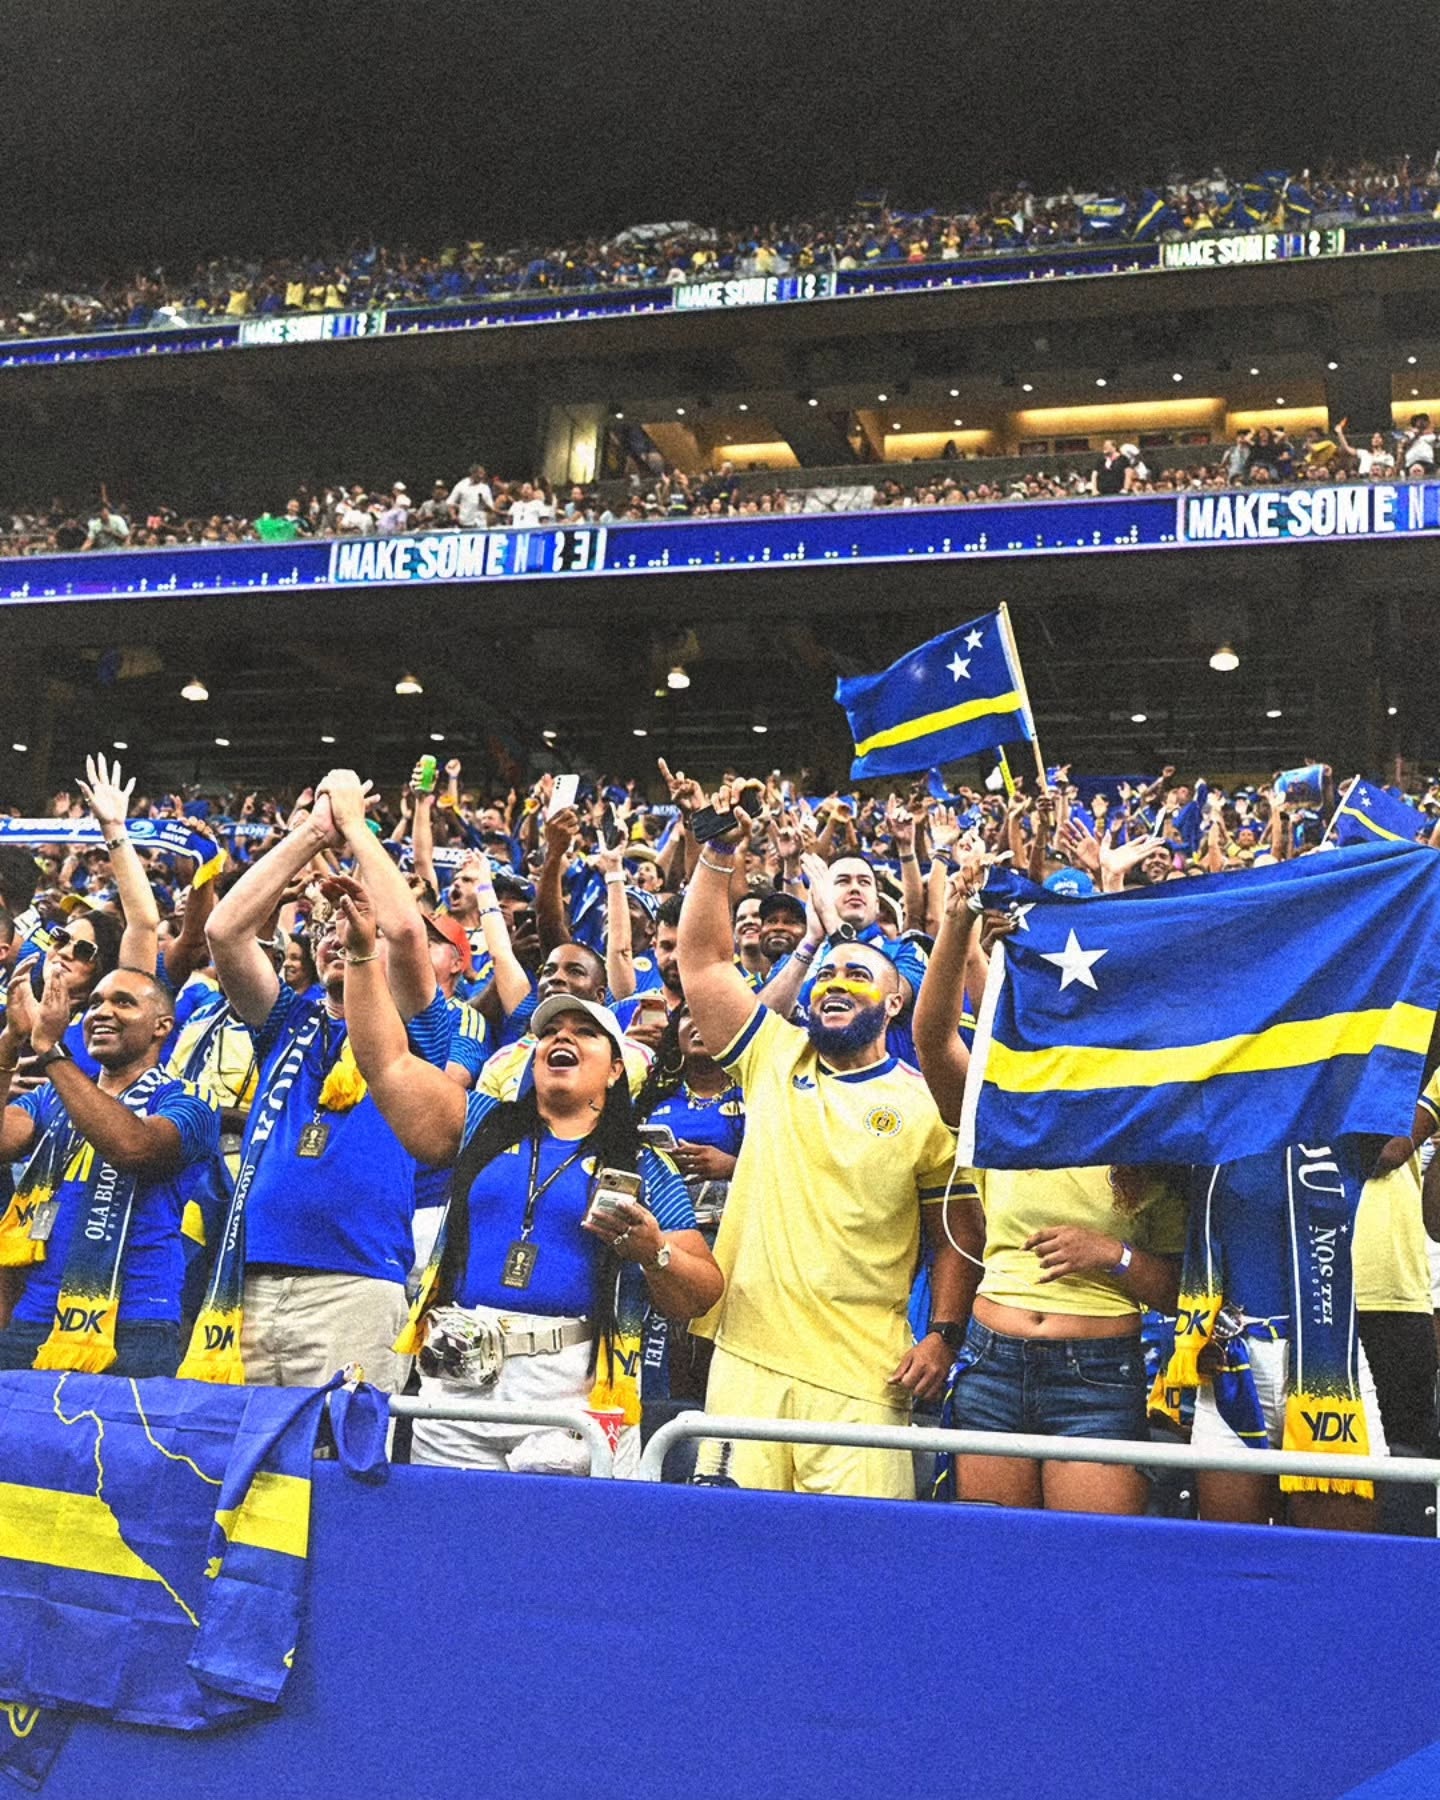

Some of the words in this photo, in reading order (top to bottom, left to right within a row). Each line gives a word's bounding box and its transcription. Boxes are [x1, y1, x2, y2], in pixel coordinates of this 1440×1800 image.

[1188, 492, 1280, 539] MAKE
[1281, 485, 1398, 537] SOME
[337, 539, 411, 582] MAKE
[415, 533, 508, 579] SOME
[84, 1206, 110, 1241] OLA
[1314, 1225, 1338, 1278] NOS
[56, 1307, 107, 1334] YDK
[1300, 1411, 1358, 1444] YDK
